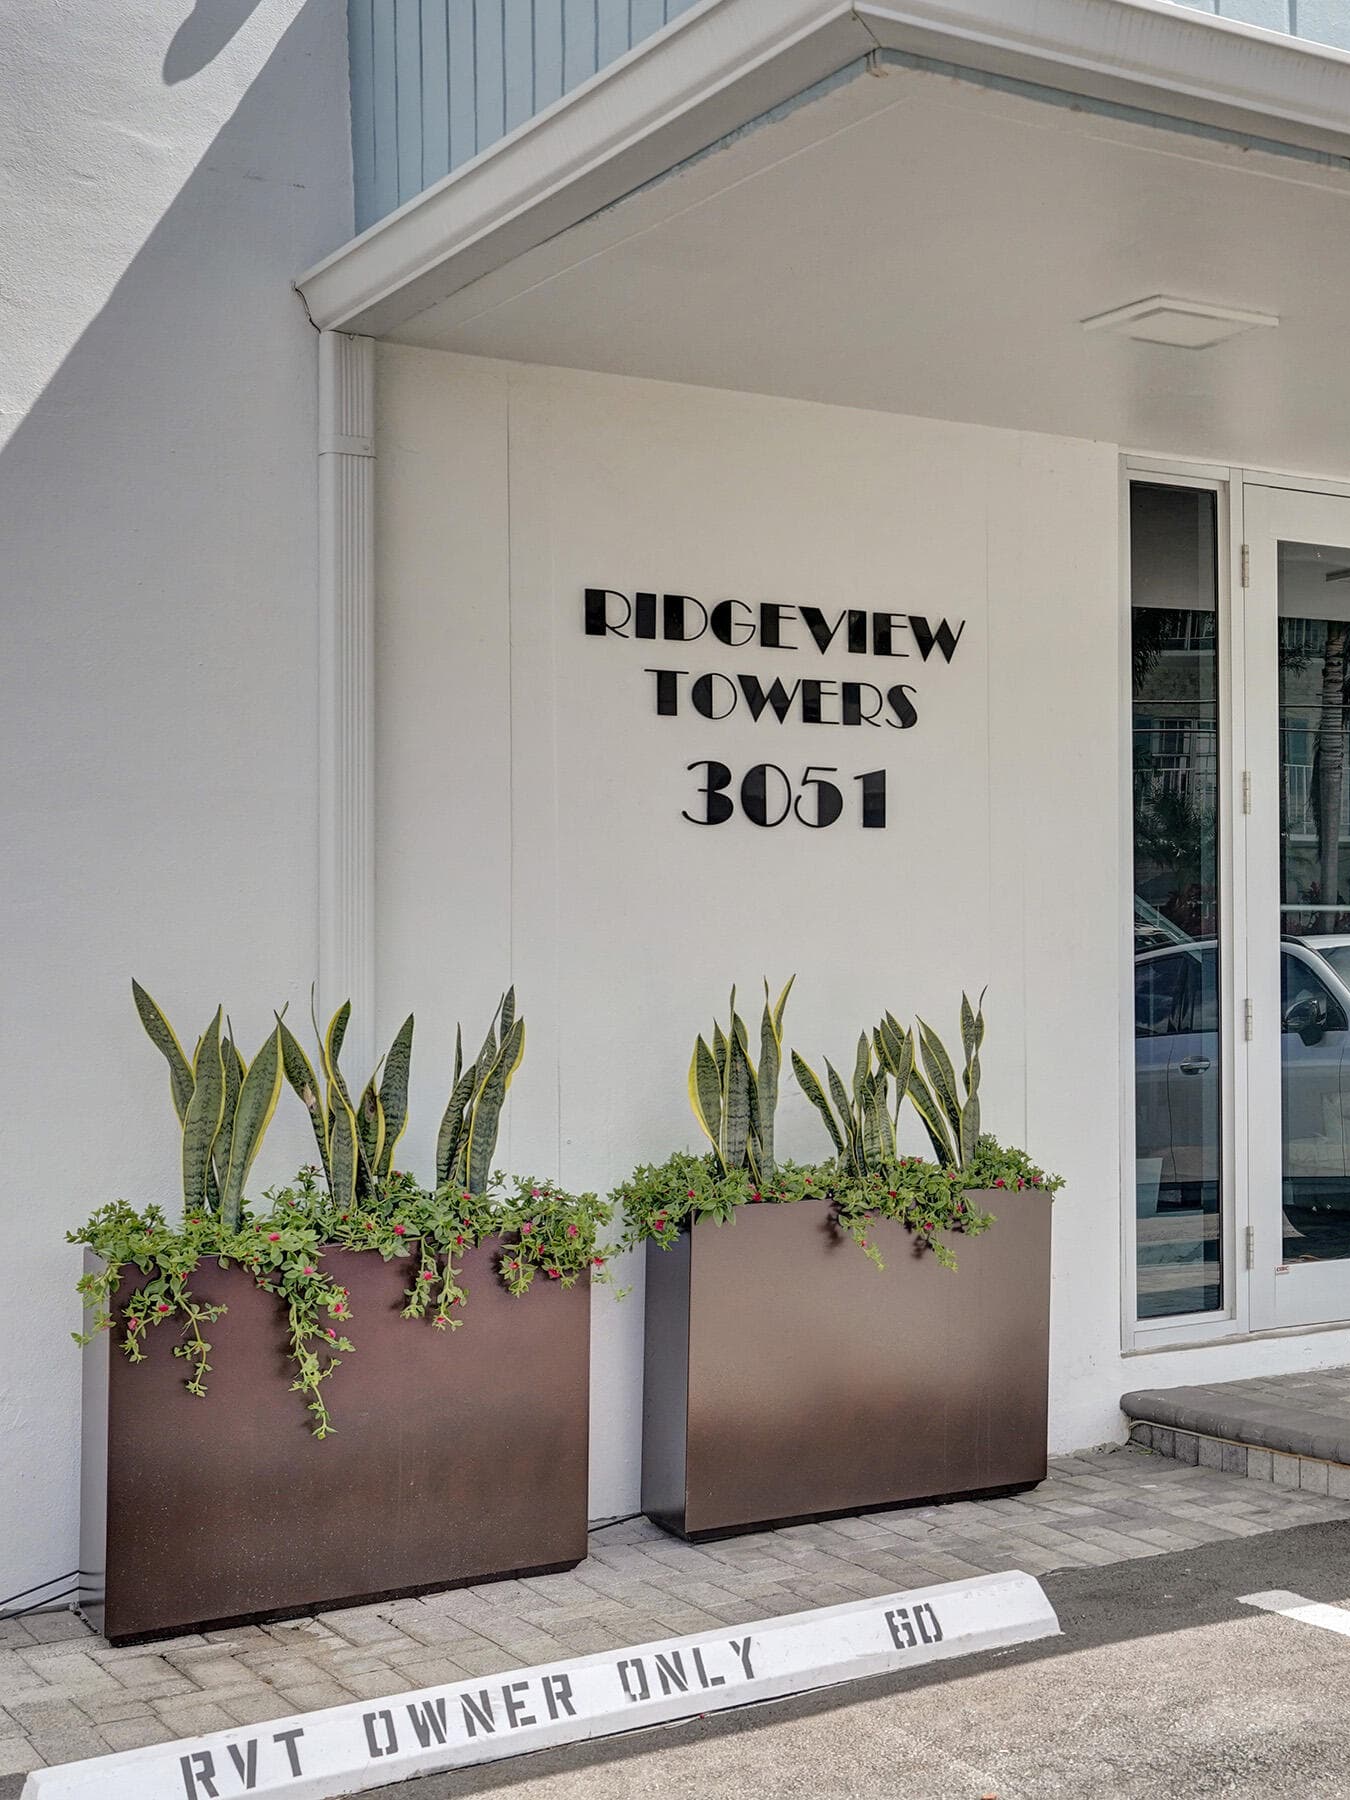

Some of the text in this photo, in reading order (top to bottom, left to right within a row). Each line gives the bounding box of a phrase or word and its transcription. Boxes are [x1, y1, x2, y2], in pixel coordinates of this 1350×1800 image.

[584, 588, 966, 664] RIDGEVIEW
[644, 668, 919, 729] TOWERS
[681, 760, 887, 829] 3051
[179, 1602, 944, 1800] RVT OWNER ONLY 60
